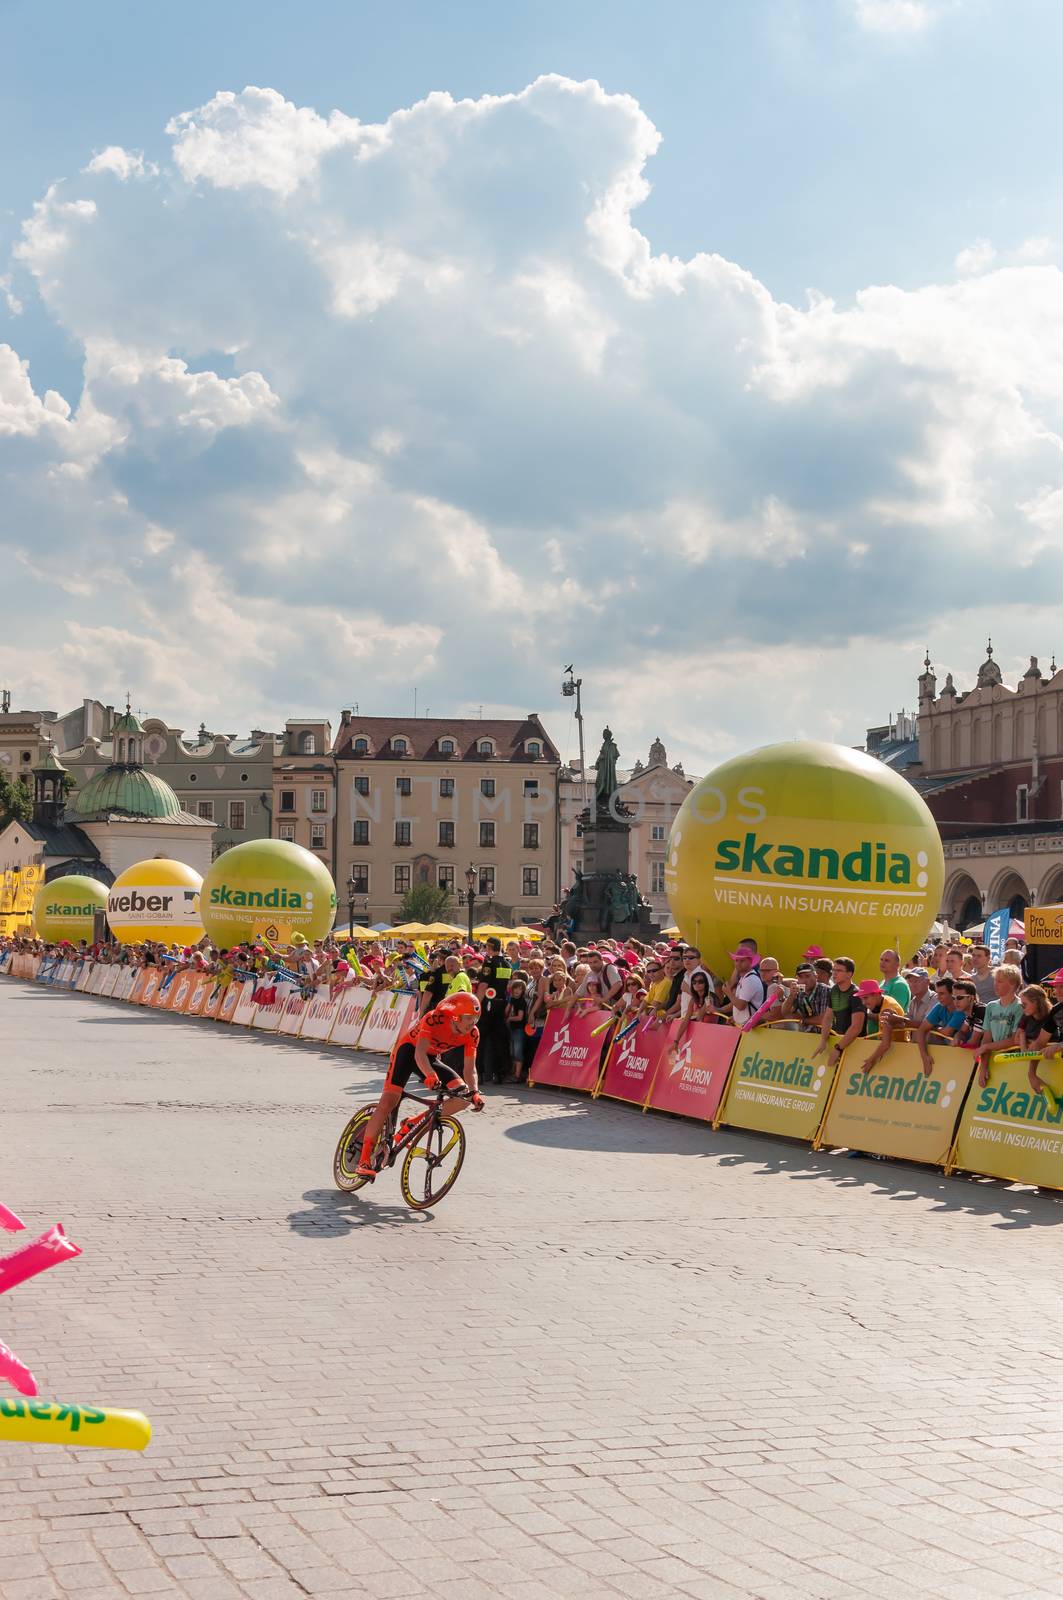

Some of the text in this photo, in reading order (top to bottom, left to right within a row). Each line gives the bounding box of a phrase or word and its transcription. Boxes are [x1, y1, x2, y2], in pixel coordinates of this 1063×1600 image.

[45, 903, 104, 916] skandi
[108, 891, 173, 912] weber
[714, 888, 925, 919] VIENNA INSURANCE GROUP
[1030, 914, 1045, 927] Pro
[315, 1001, 337, 1021] LOTOS
[377, 1008, 401, 1031] LOTOS
[560, 1045, 589, 1060] TAURON
[625, 1054, 650, 1072] TAURON
[681, 1066, 713, 1086] TAURON
[734, 1088, 816, 1112] VIENNA INSURANCE GROUP
[969, 1125, 1061, 1154] VIENNA INSURANCE
